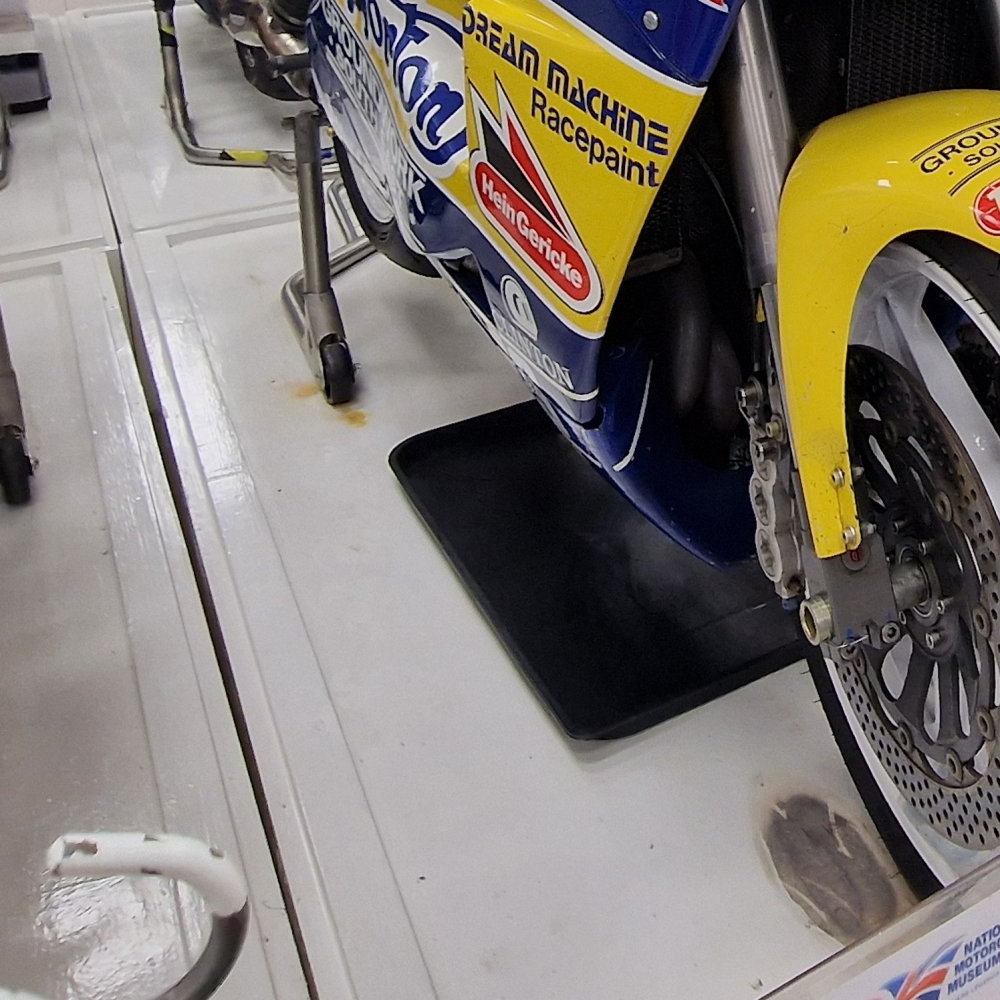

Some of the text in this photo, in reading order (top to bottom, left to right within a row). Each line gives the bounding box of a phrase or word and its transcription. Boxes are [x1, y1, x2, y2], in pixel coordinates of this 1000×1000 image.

[462, 3, 670, 157] DREAM MACHINE
[531, 87, 660, 189] Racepaint
[481, 172, 583, 289] HeinGericke
